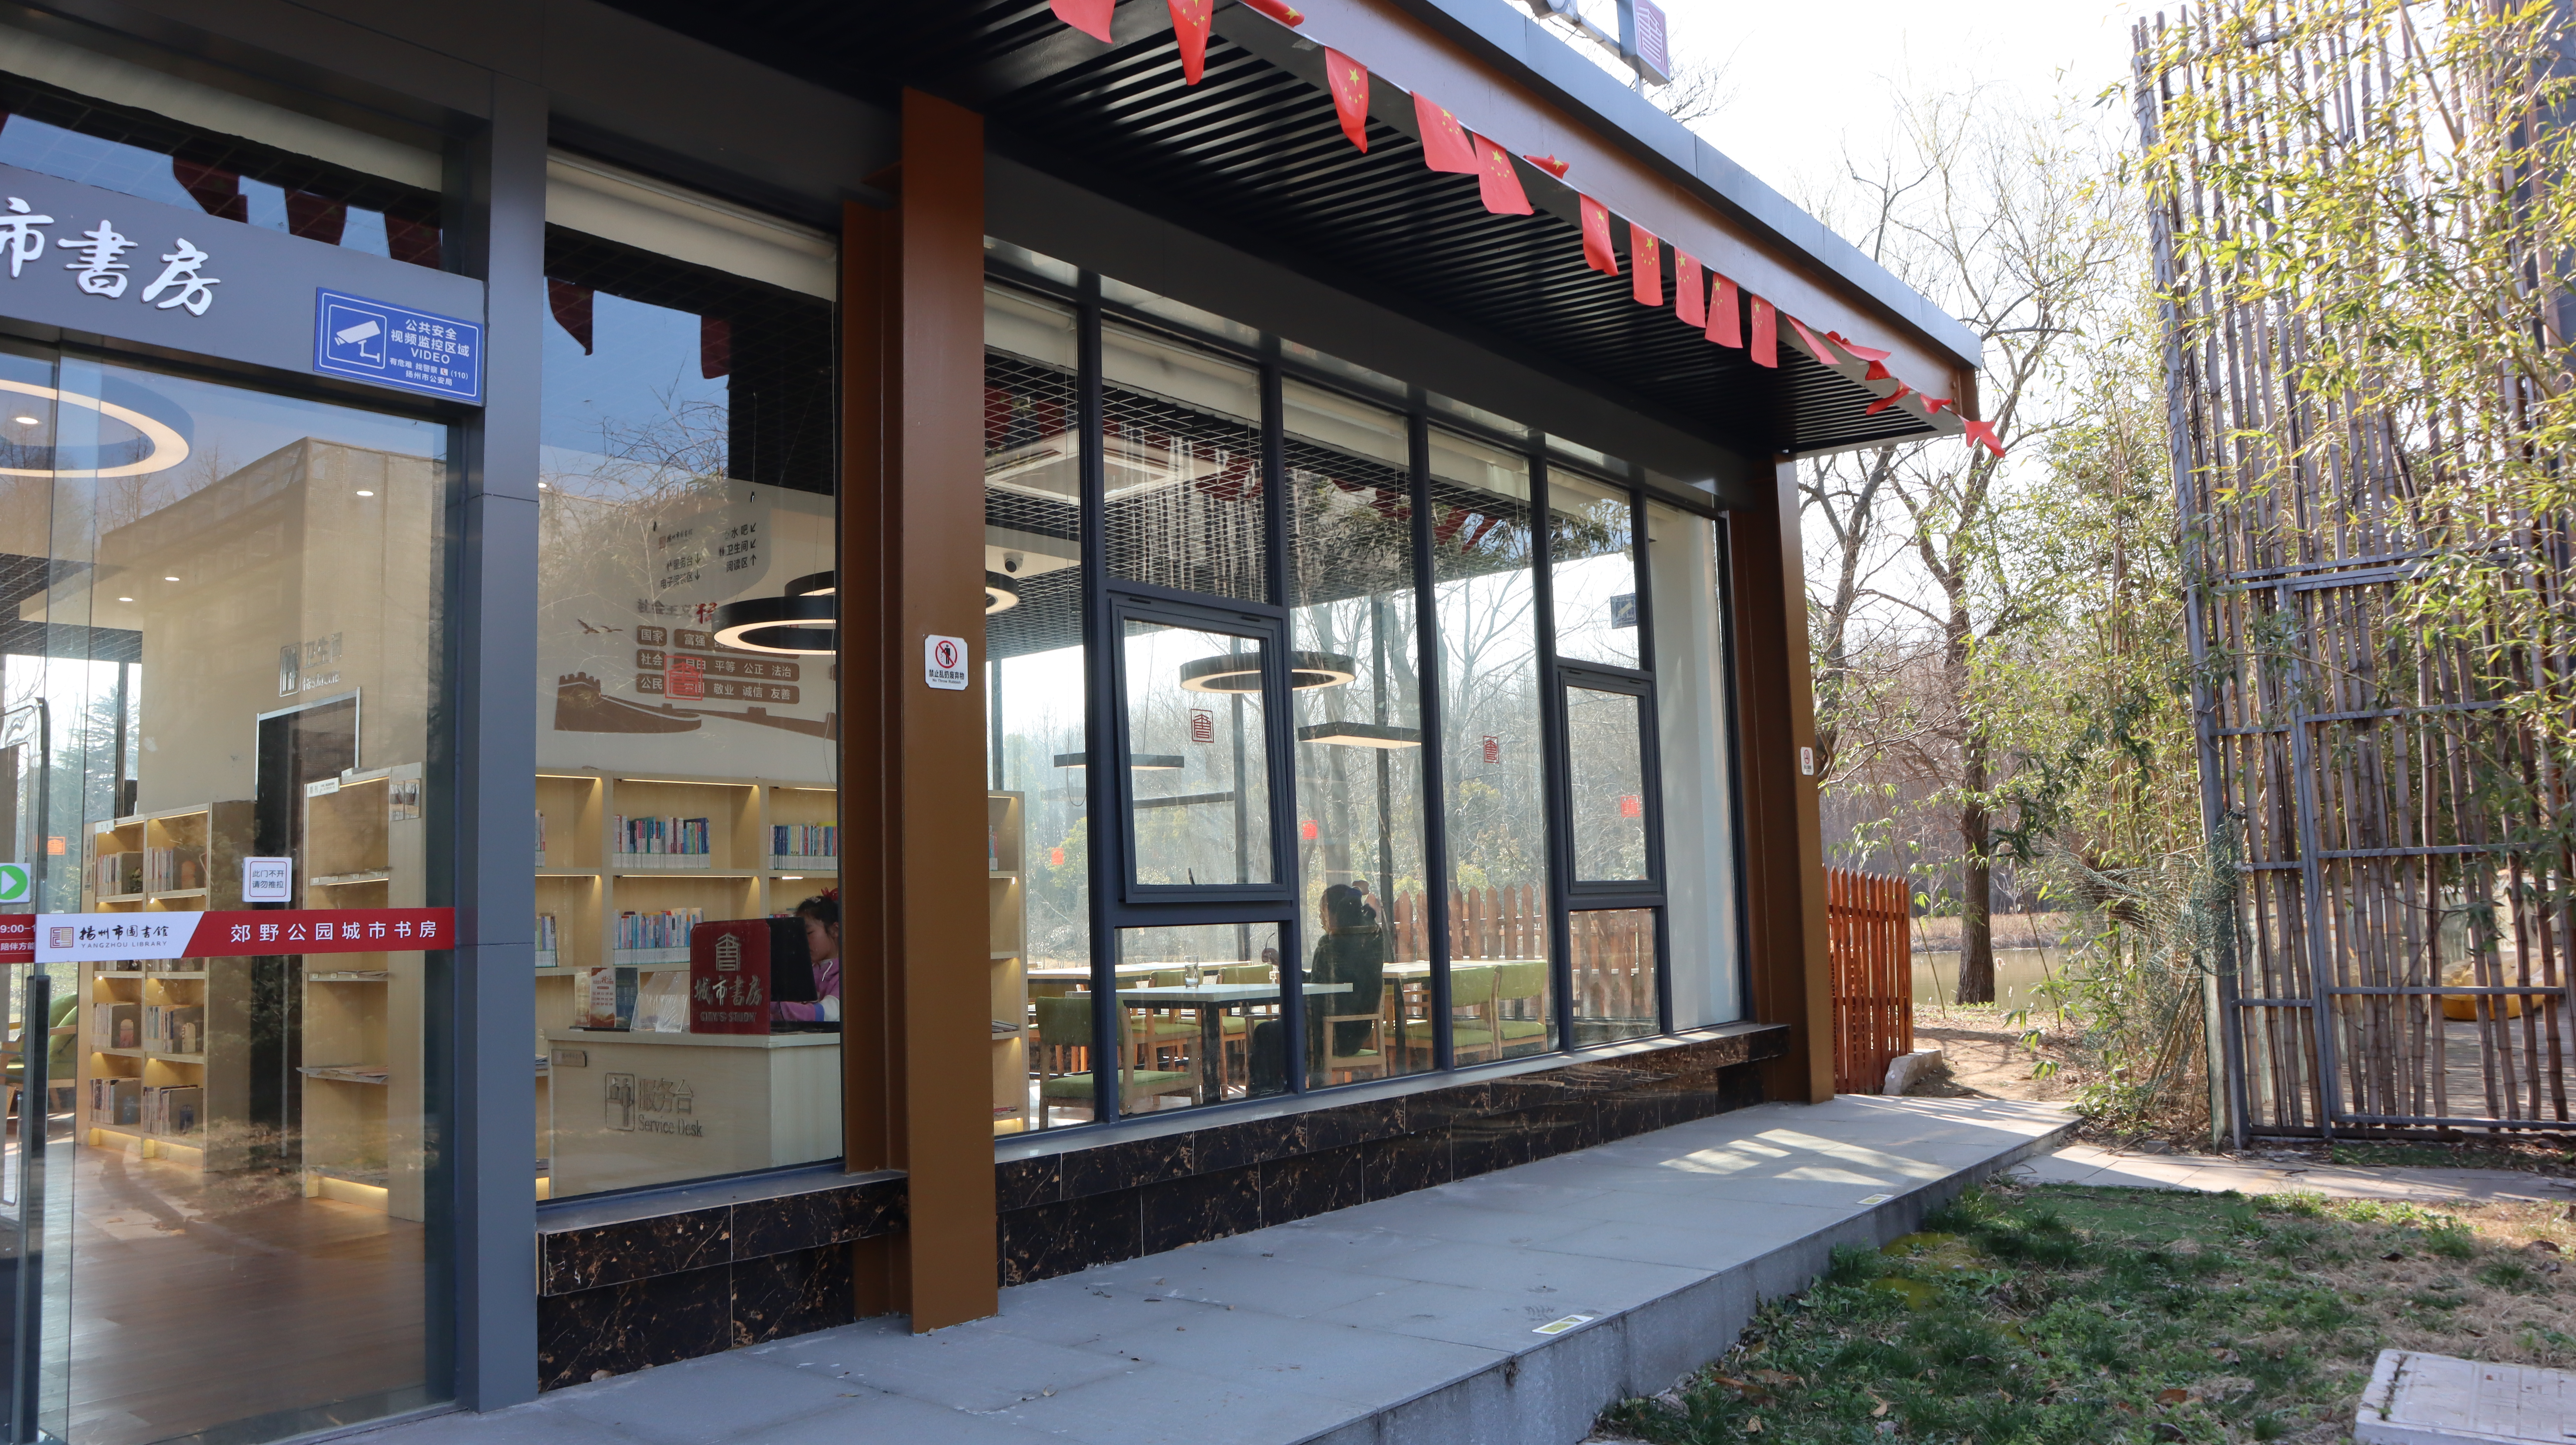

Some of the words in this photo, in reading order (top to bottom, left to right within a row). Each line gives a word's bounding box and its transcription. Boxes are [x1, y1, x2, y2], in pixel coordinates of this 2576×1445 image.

[405, 319, 457, 340] 公共安全
[391, 329, 469, 357] 视频监控区域
[411, 348, 450, 364] VIDEO
[390, 358, 412, 368] 有危难
[416, 363, 437, 374] 找警察
[451, 370, 468, 380] (110)
[406, 370, 452, 386] 扬州市公安局
[727, 540, 748, 556] 卫生间
[674, 556, 692, 570] 服务台
[727, 557, 748, 573] 阅读区
[661, 572, 692, 589] 电子阅读区
[641, 629, 664, 641] 国家
[685, 634, 705, 646] 富强
[641, 653, 663, 665] 社会
[715, 660, 735, 672] 平等
[744, 663, 764, 675] 公正
[772, 666, 791, 677] 法治
[929, 669, 964, 680] 禁止乱扔废弃物
[641, 677, 663, 689] 公民
[714, 683, 734, 695] 敬业
[743, 685, 762, 697] 诚信
[771, 688, 790, 700] 友善
[252, 881, 284, 889] 请勿推拉
[231, 920, 437, 943] 郊野公园城市书房
[0, 942, 35, 951] 陪伴方能
[694, 975, 763, 1006] 城市書房
[729, 1012, 757, 1022] STUDY
[639, 1077, 694, 1114] 服务台
[638, 1114, 675, 1134] Service
[678, 1118, 703, 1137] Desk
